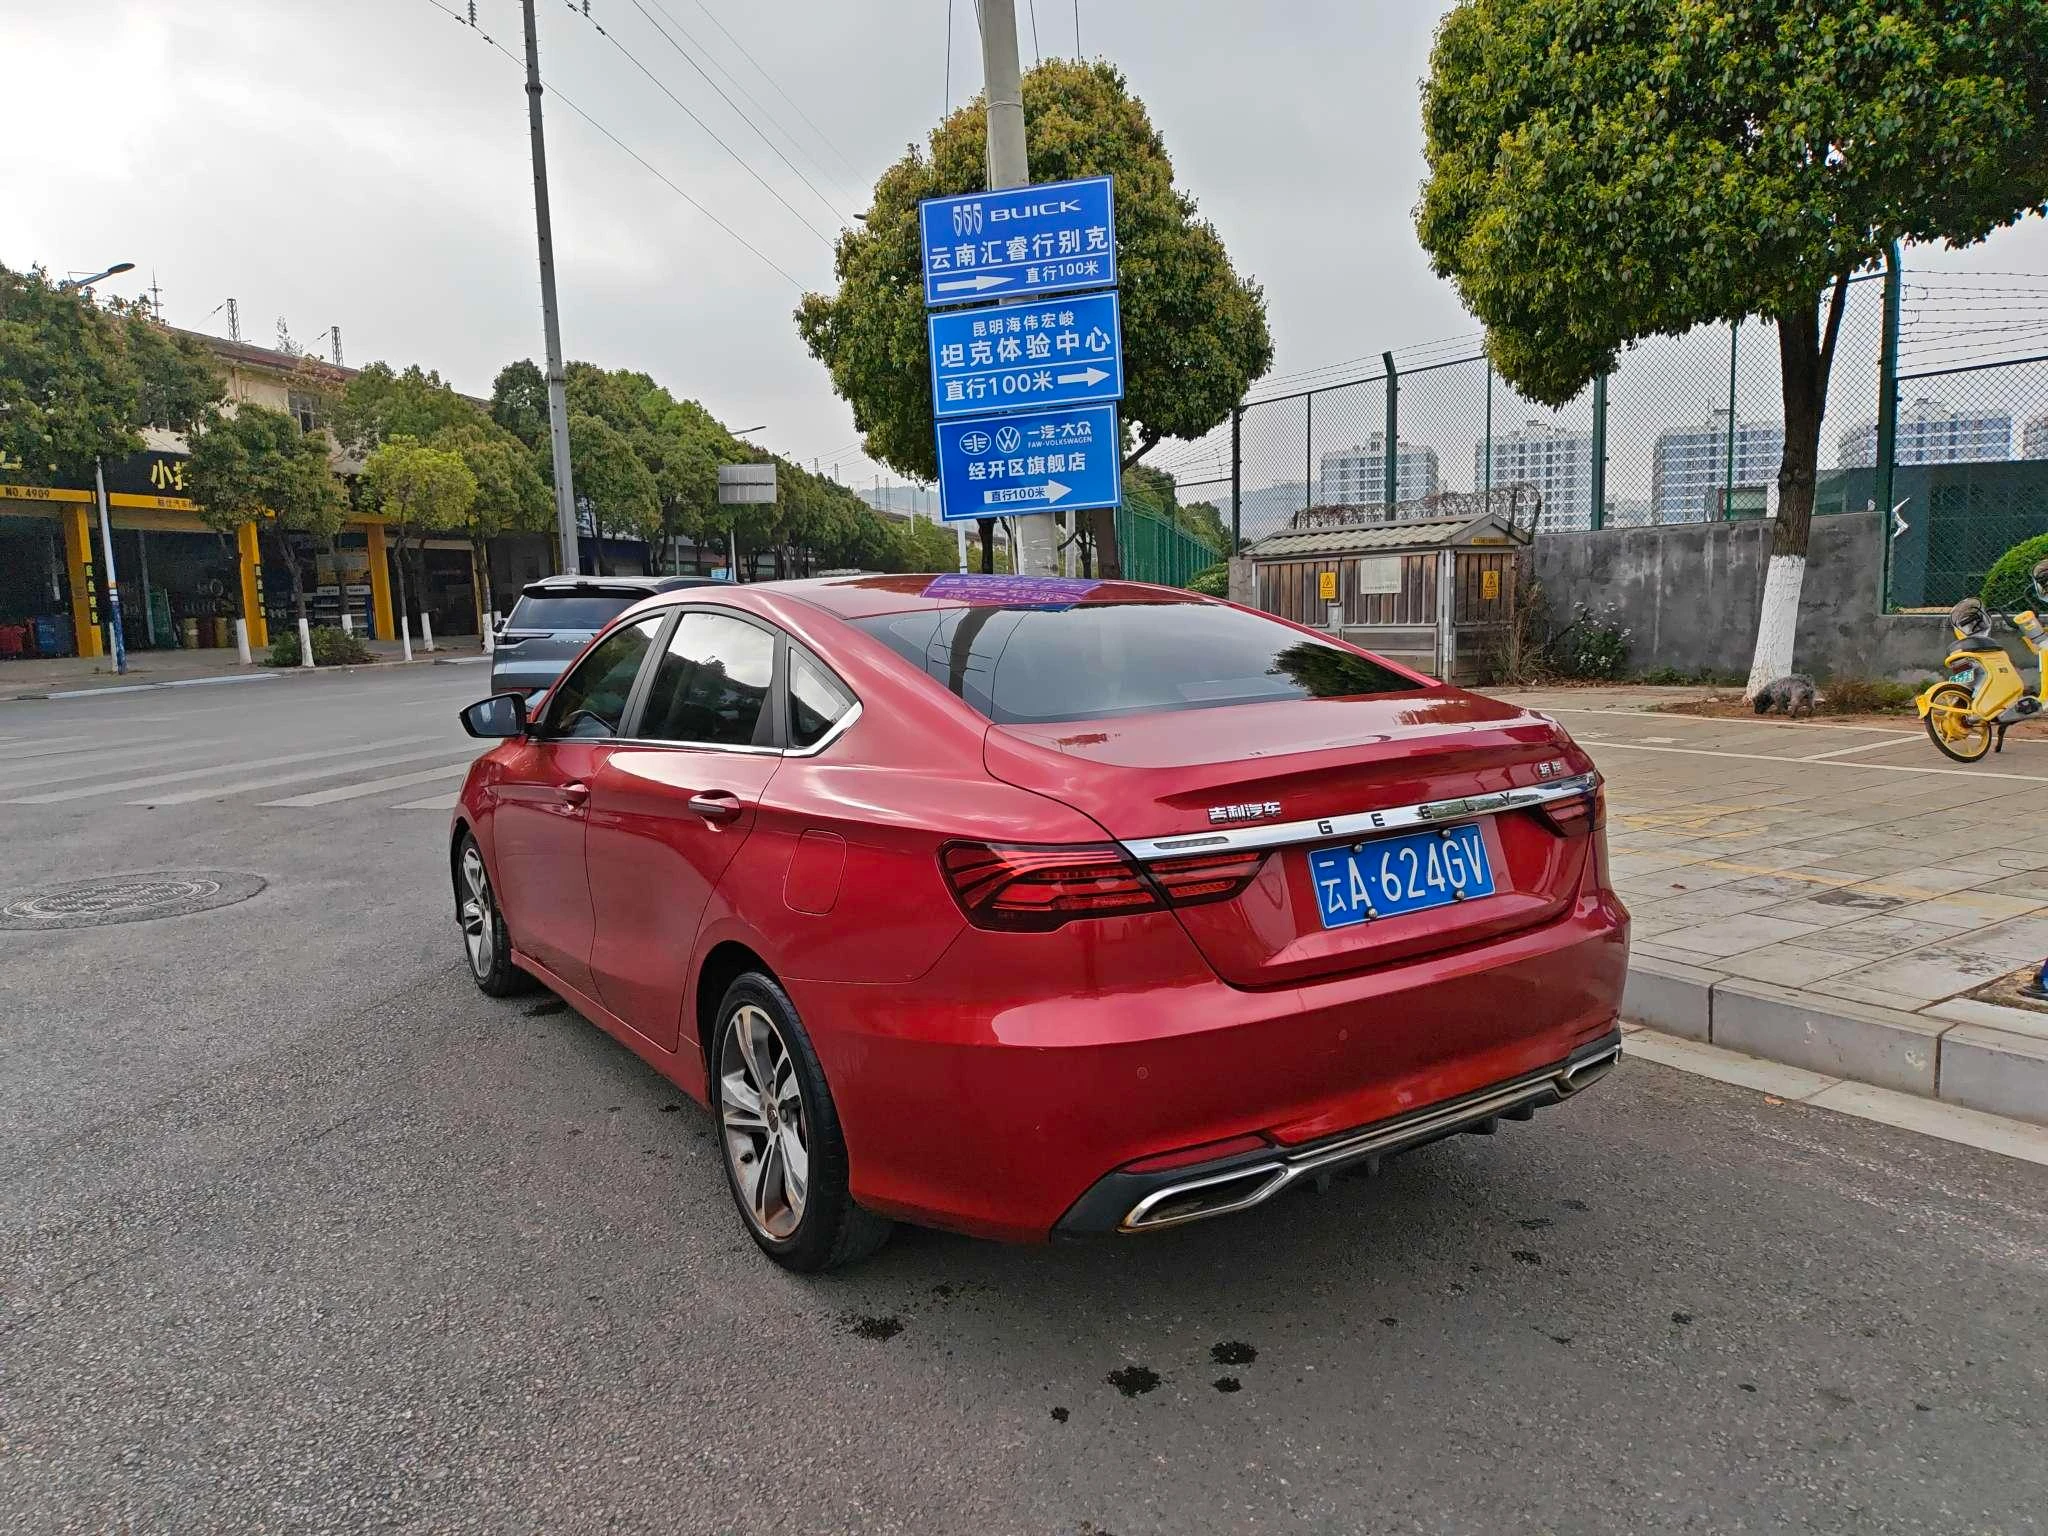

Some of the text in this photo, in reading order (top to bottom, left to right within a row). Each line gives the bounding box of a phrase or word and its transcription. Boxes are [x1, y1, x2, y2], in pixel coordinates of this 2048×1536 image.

[990, 199, 1082, 222] BUICK
[930, 225, 1109, 270] 云南汇睿行别克
[1025, 260, 1099, 284] 直行100米
[973, 310, 1075, 338] 昆明海伟宏峻
[940, 326, 1111, 368] 坦克体验中心
[945, 370, 1054, 401] 直行100米
[968, 452, 1086, 481] 经开区旗舰店
[991, 487, 1046, 502] 直行100米
[1208, 802, 1282, 823] 吉利汽车
[1317, 791, 1511, 835] GEELY
